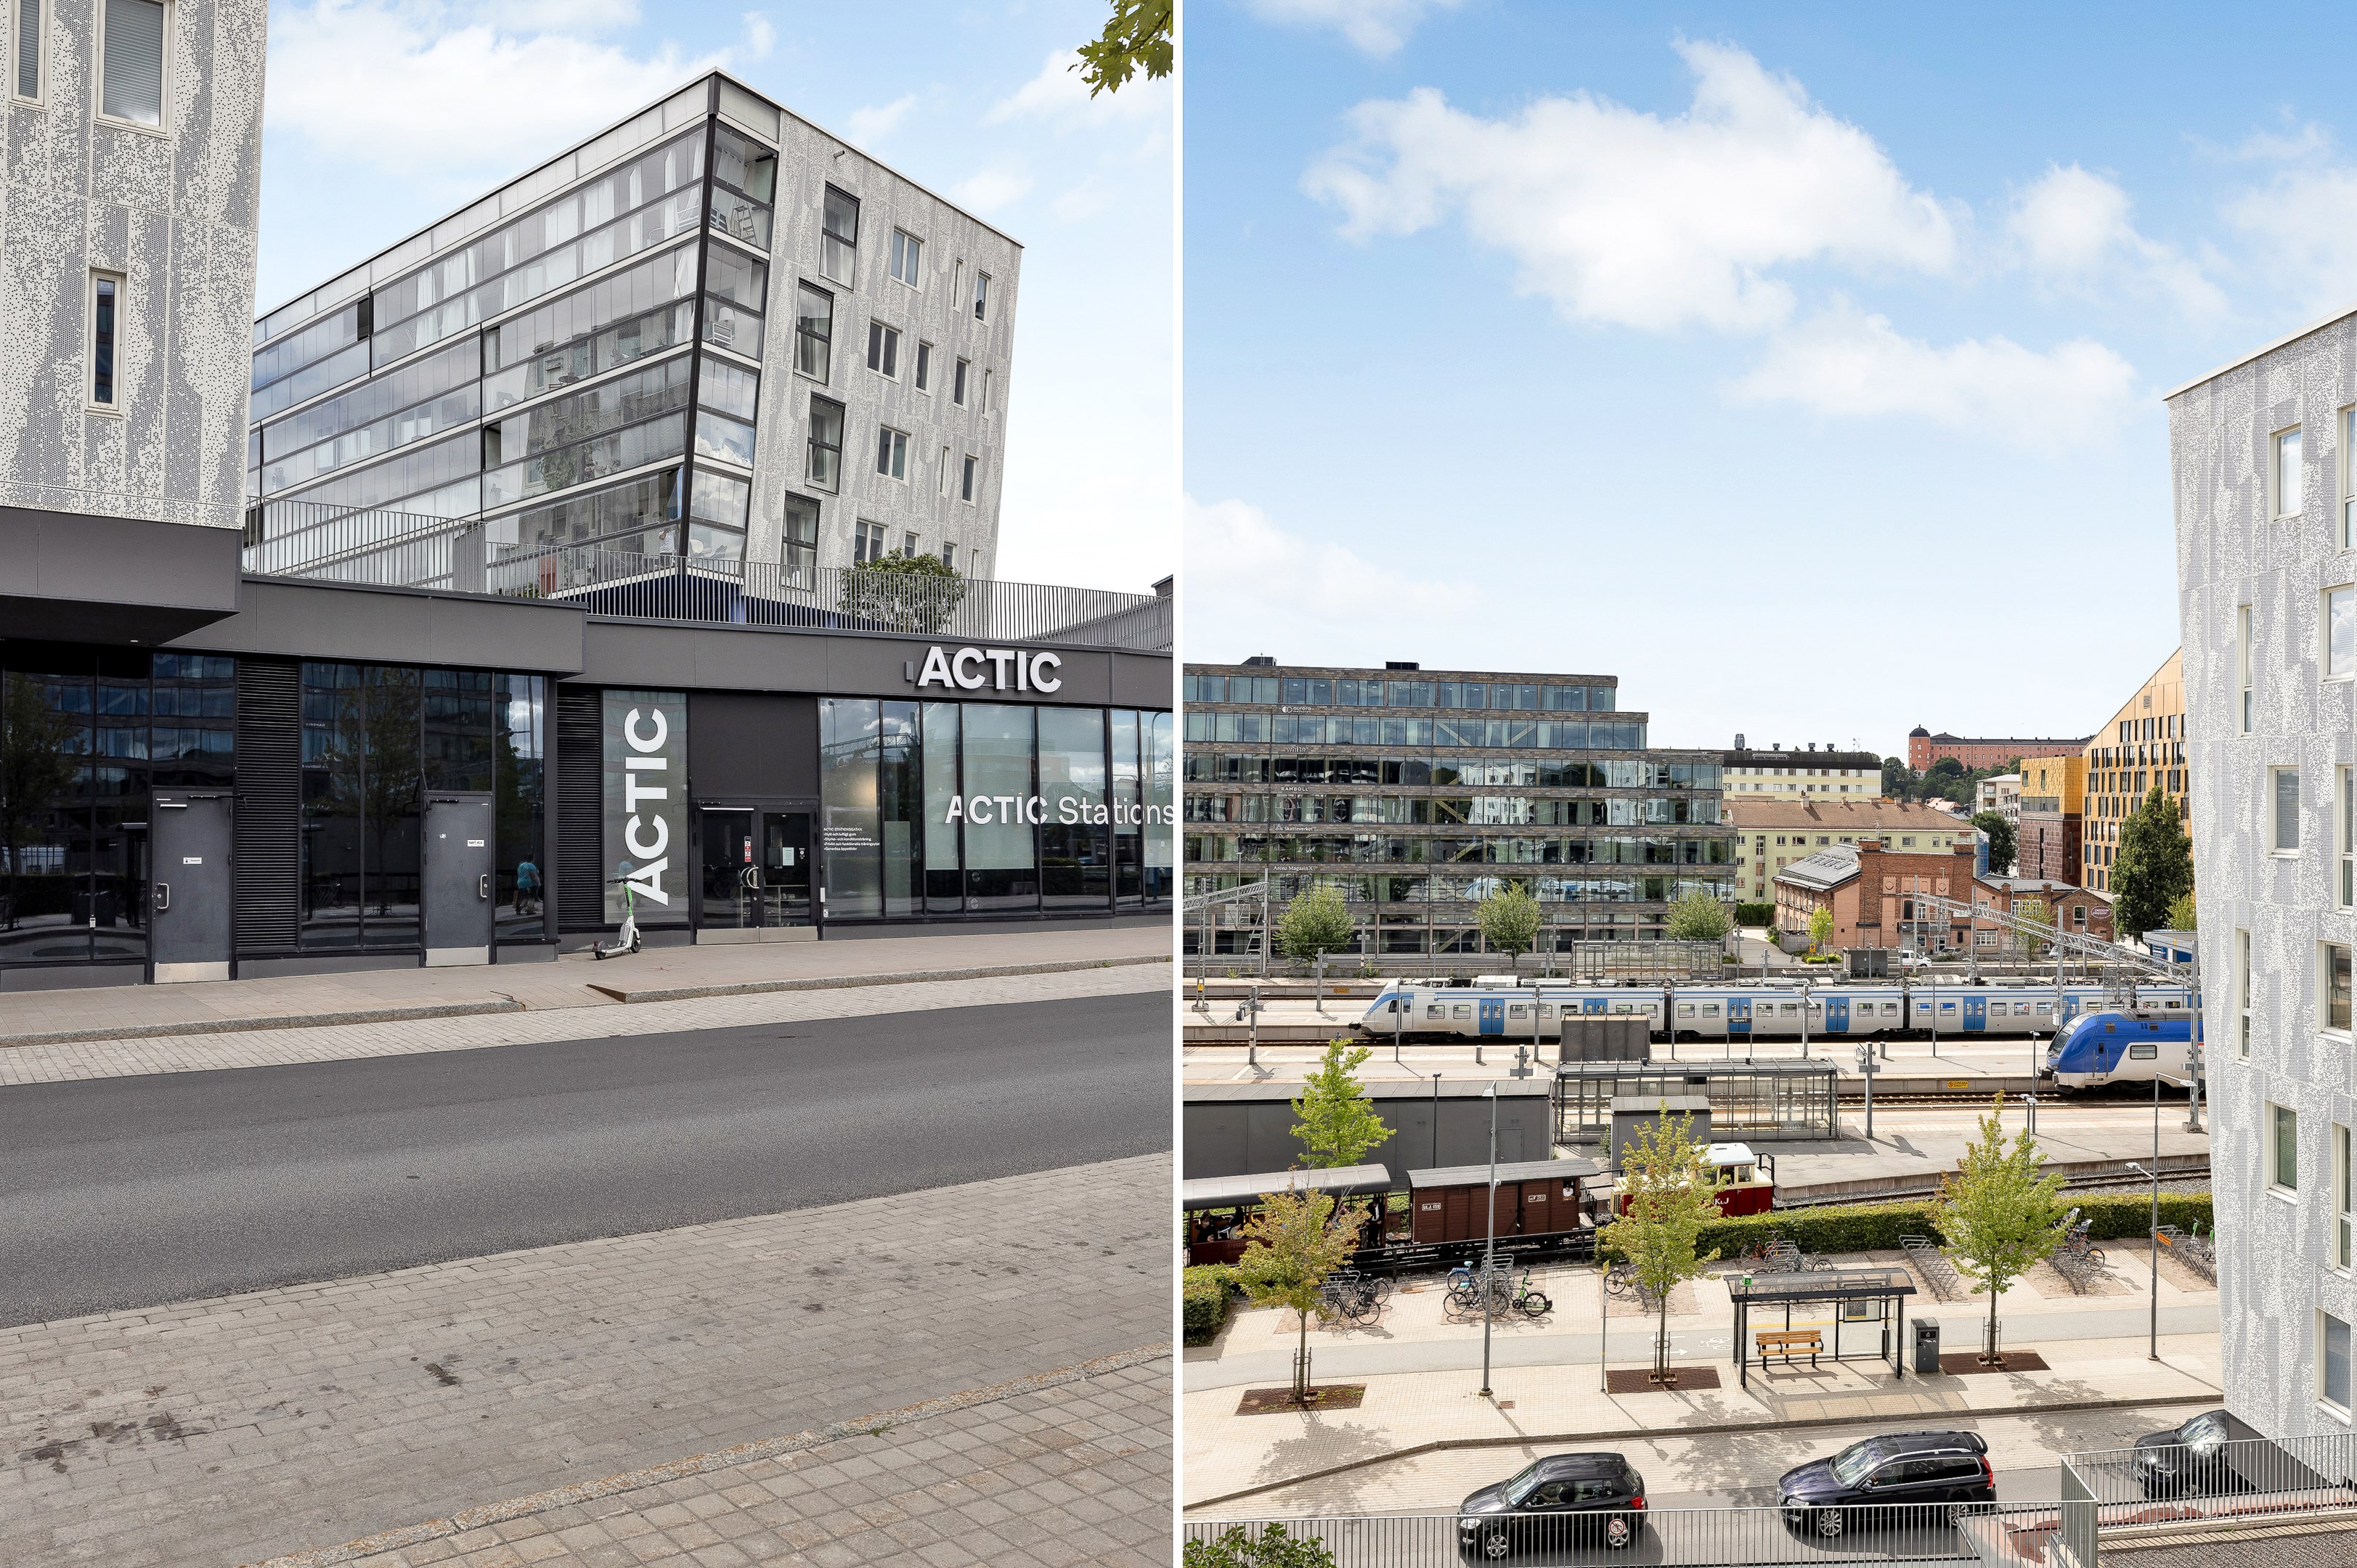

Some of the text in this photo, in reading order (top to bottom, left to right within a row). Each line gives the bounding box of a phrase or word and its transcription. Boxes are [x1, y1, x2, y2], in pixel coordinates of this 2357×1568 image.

[917, 645, 1062, 693] ACTIC
[624, 707, 669, 906] ACTIC
[945, 795, 1173, 825] ACTIC Stations
